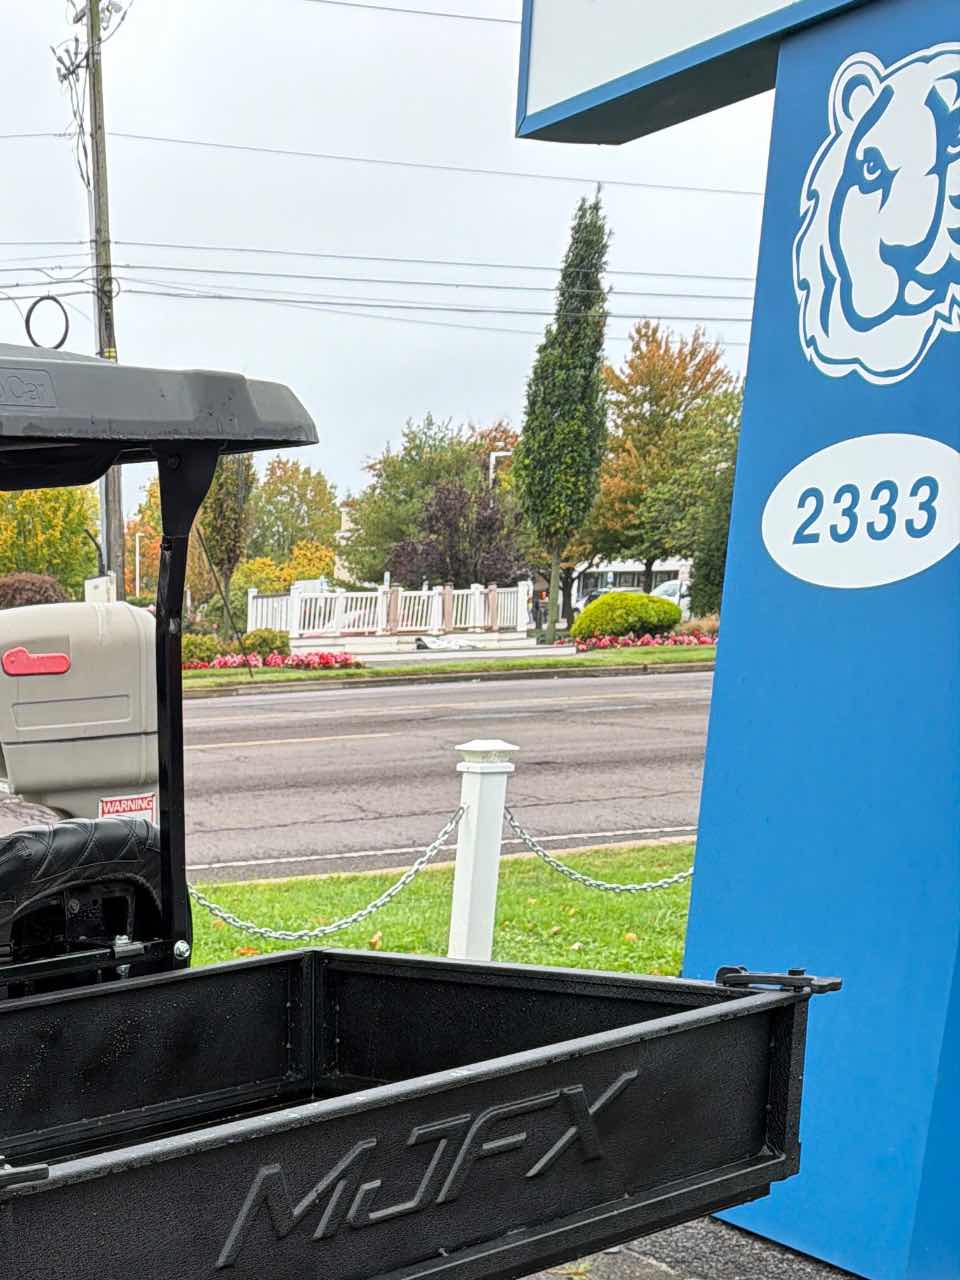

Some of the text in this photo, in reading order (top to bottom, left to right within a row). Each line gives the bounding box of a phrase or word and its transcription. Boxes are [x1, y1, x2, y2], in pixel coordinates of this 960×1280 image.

[7, 374, 45, 401] Car
[792, 475, 939, 545] 2333
[102, 796, 153, 814] WARNING
[215, 1070, 638, 1268] MJFX
